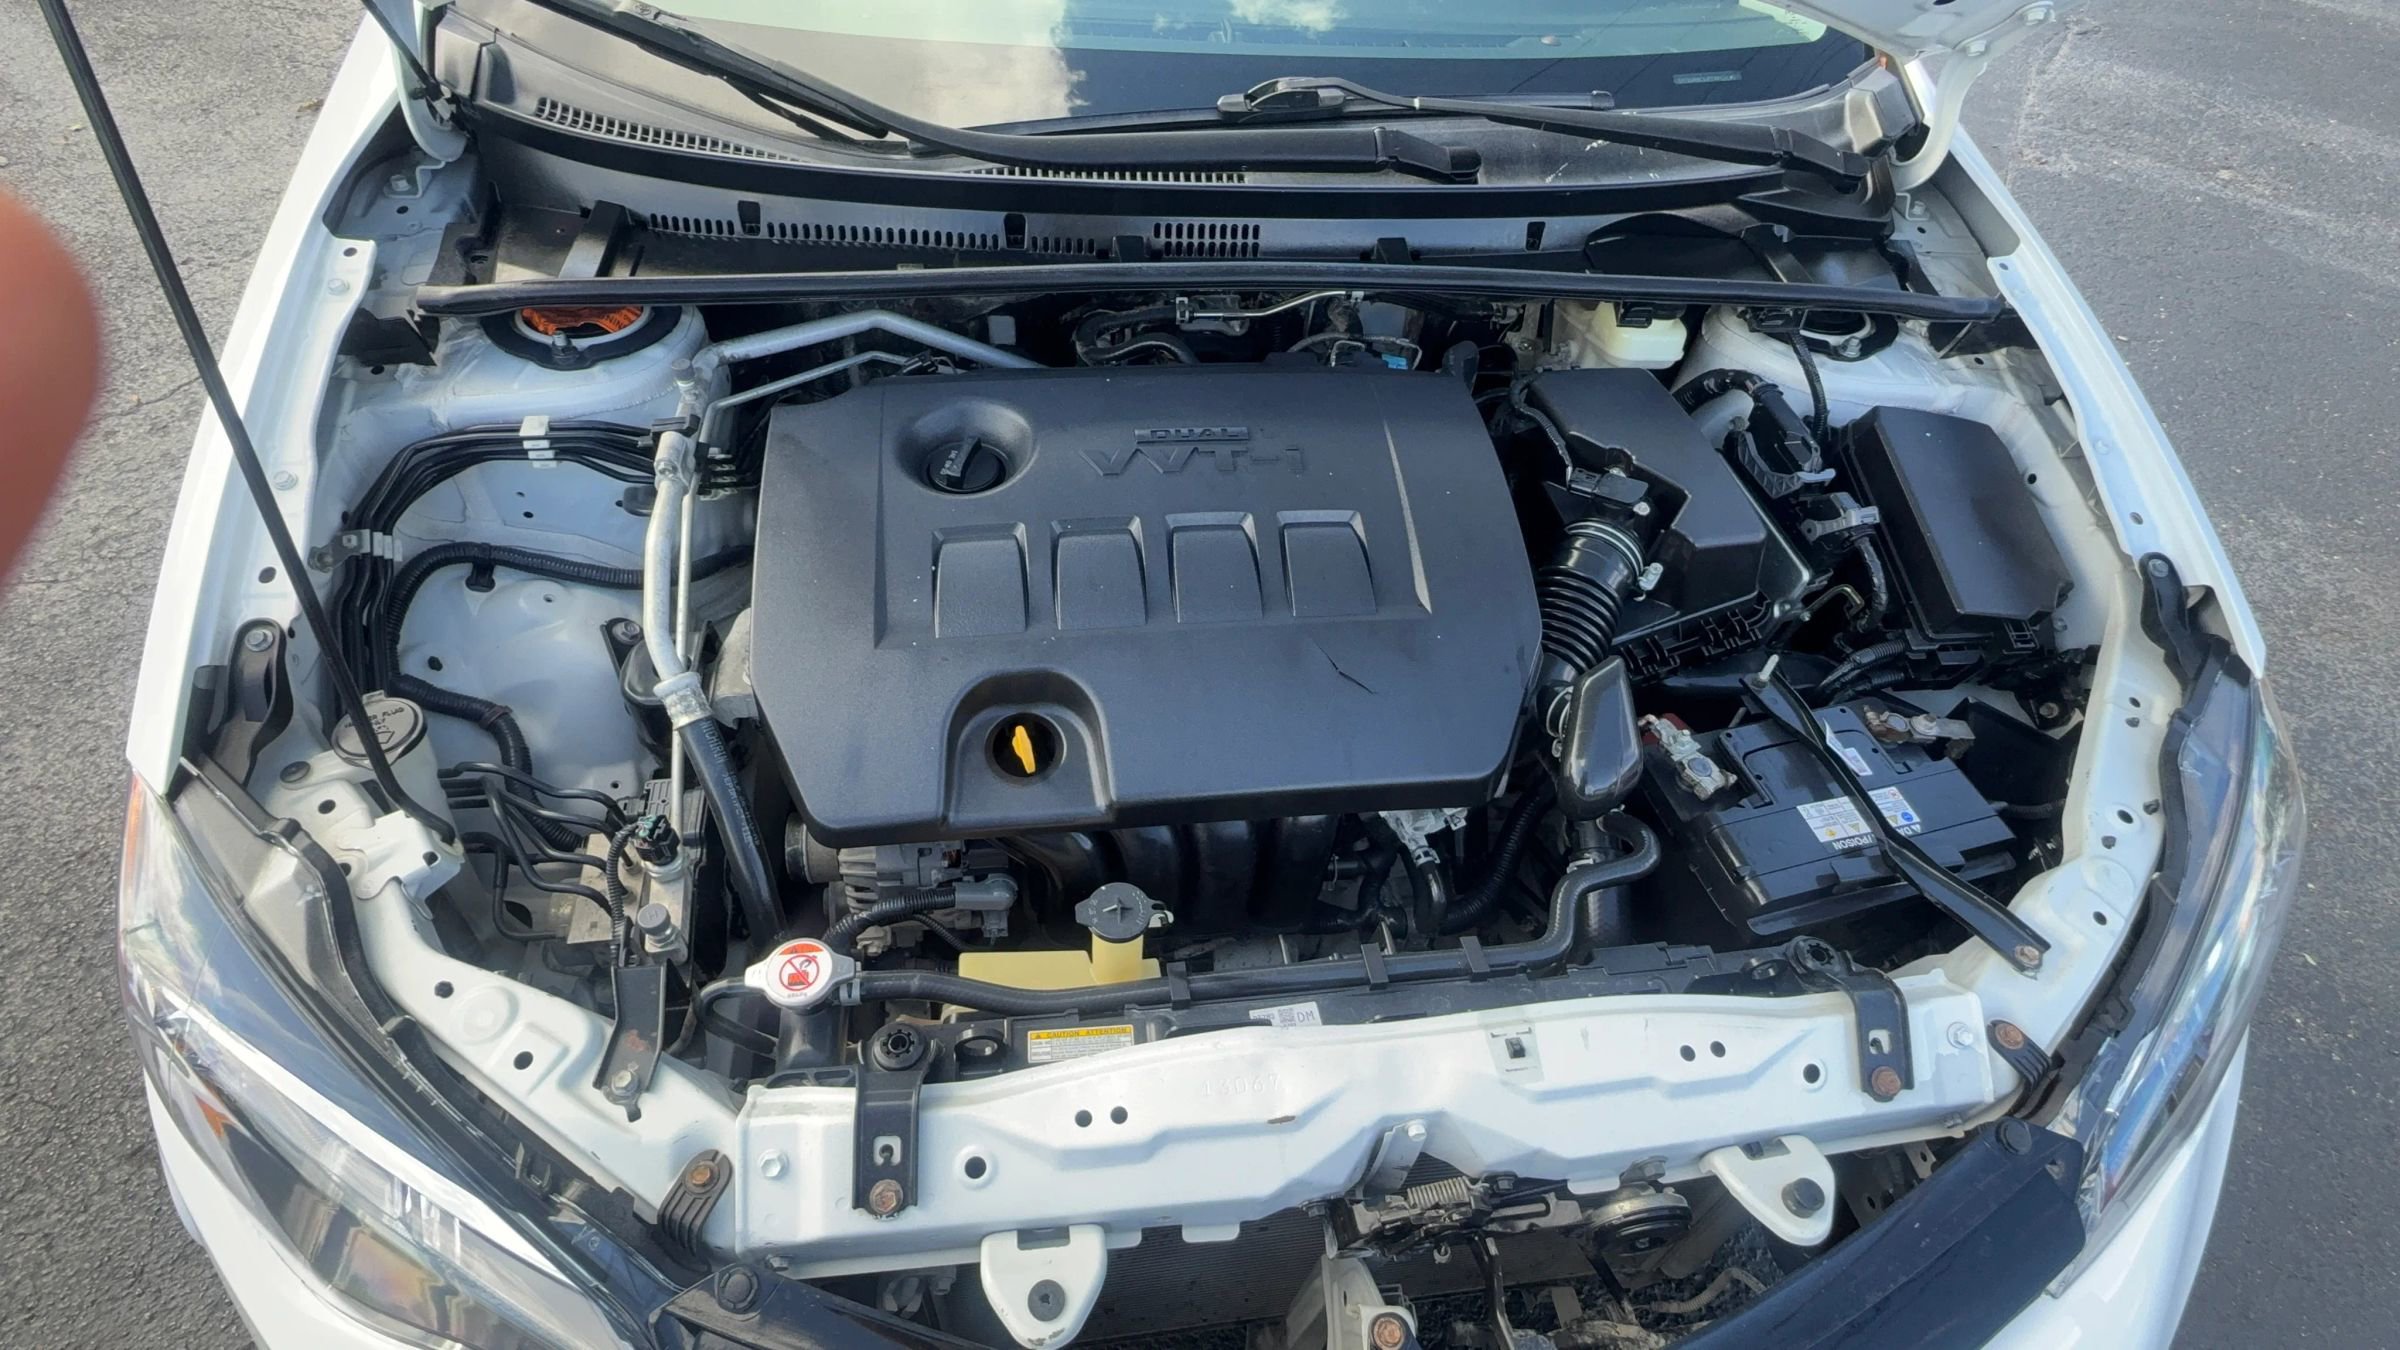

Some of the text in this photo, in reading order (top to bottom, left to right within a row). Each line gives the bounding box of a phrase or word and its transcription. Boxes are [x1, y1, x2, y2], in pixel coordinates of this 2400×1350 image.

[1148, 427, 1241, 440] DUAL
[700, 719, 729, 764] NICHIRIN
[1296, 1010, 1315, 1022] DM
[1047, 1026, 1127, 1039] CAUTION ATTENTION
